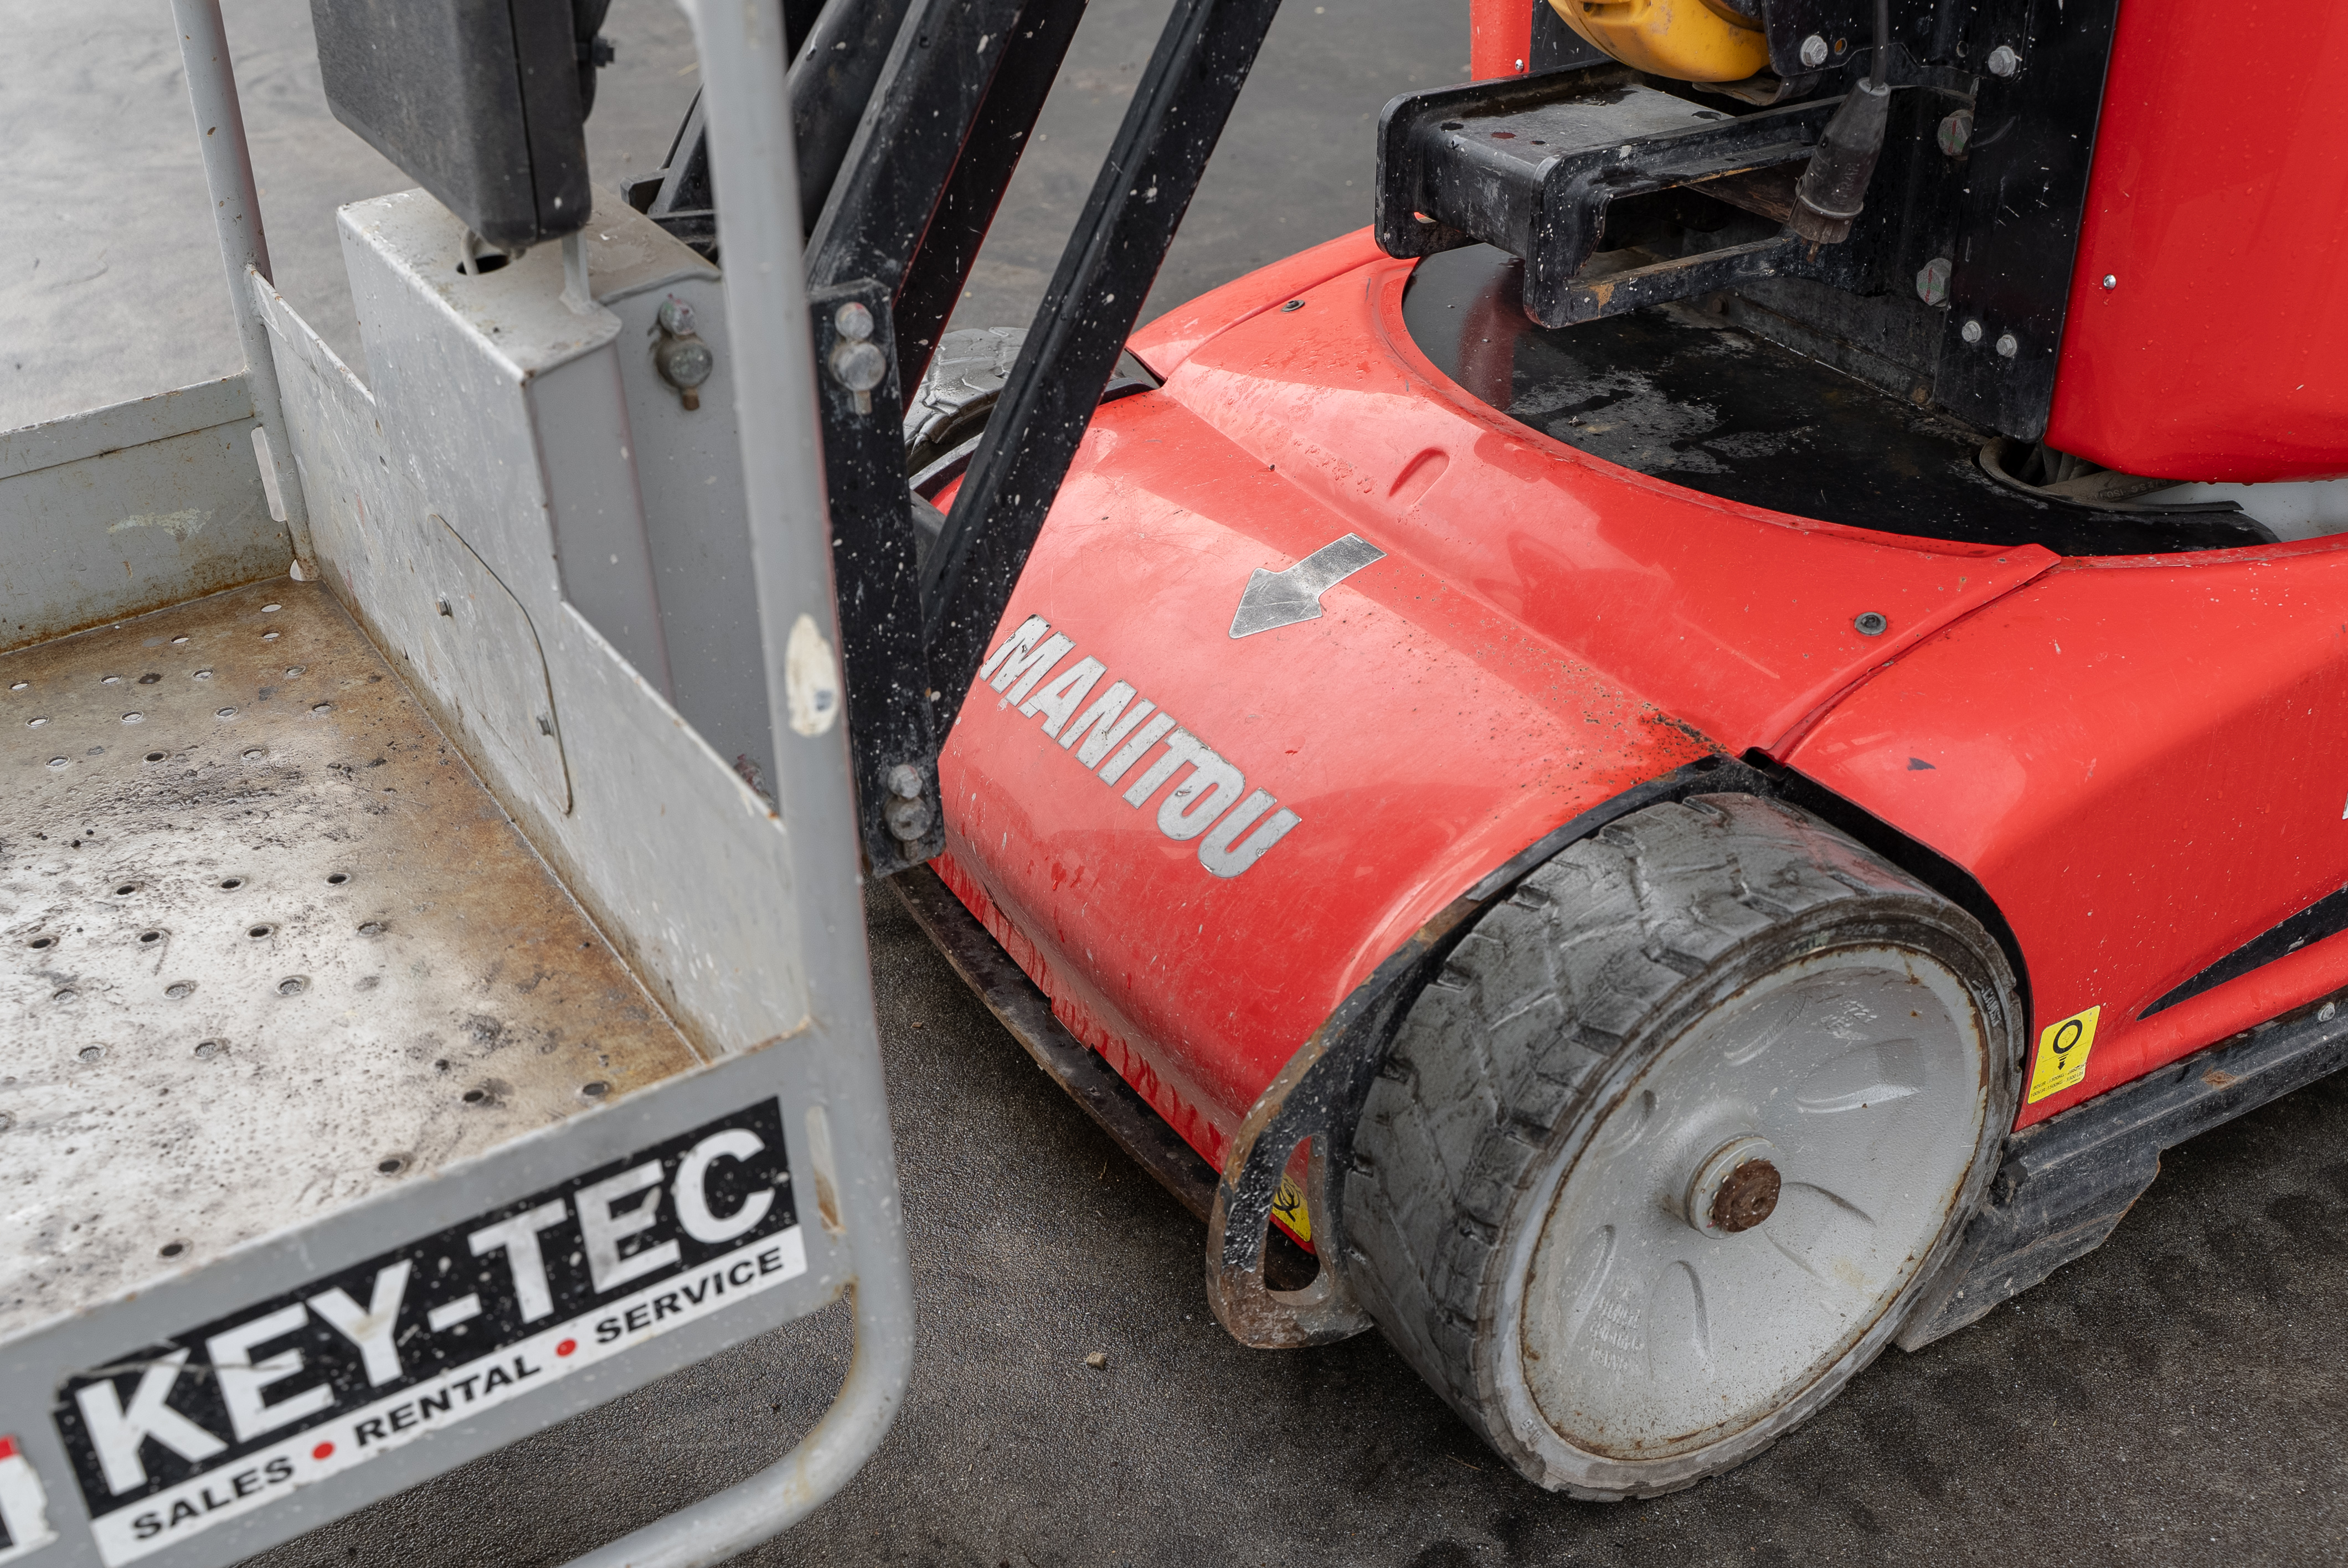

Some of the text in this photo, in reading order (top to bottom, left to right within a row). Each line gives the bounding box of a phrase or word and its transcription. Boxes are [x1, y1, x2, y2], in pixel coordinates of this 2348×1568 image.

[2107, 489, 2124, 498] ISO
[979, 613, 1302, 879] MANITOU
[76, 1127, 775, 1497] KEY-TEC
[133, 1247, 783, 1541] SALES RENTAL SERVICE
